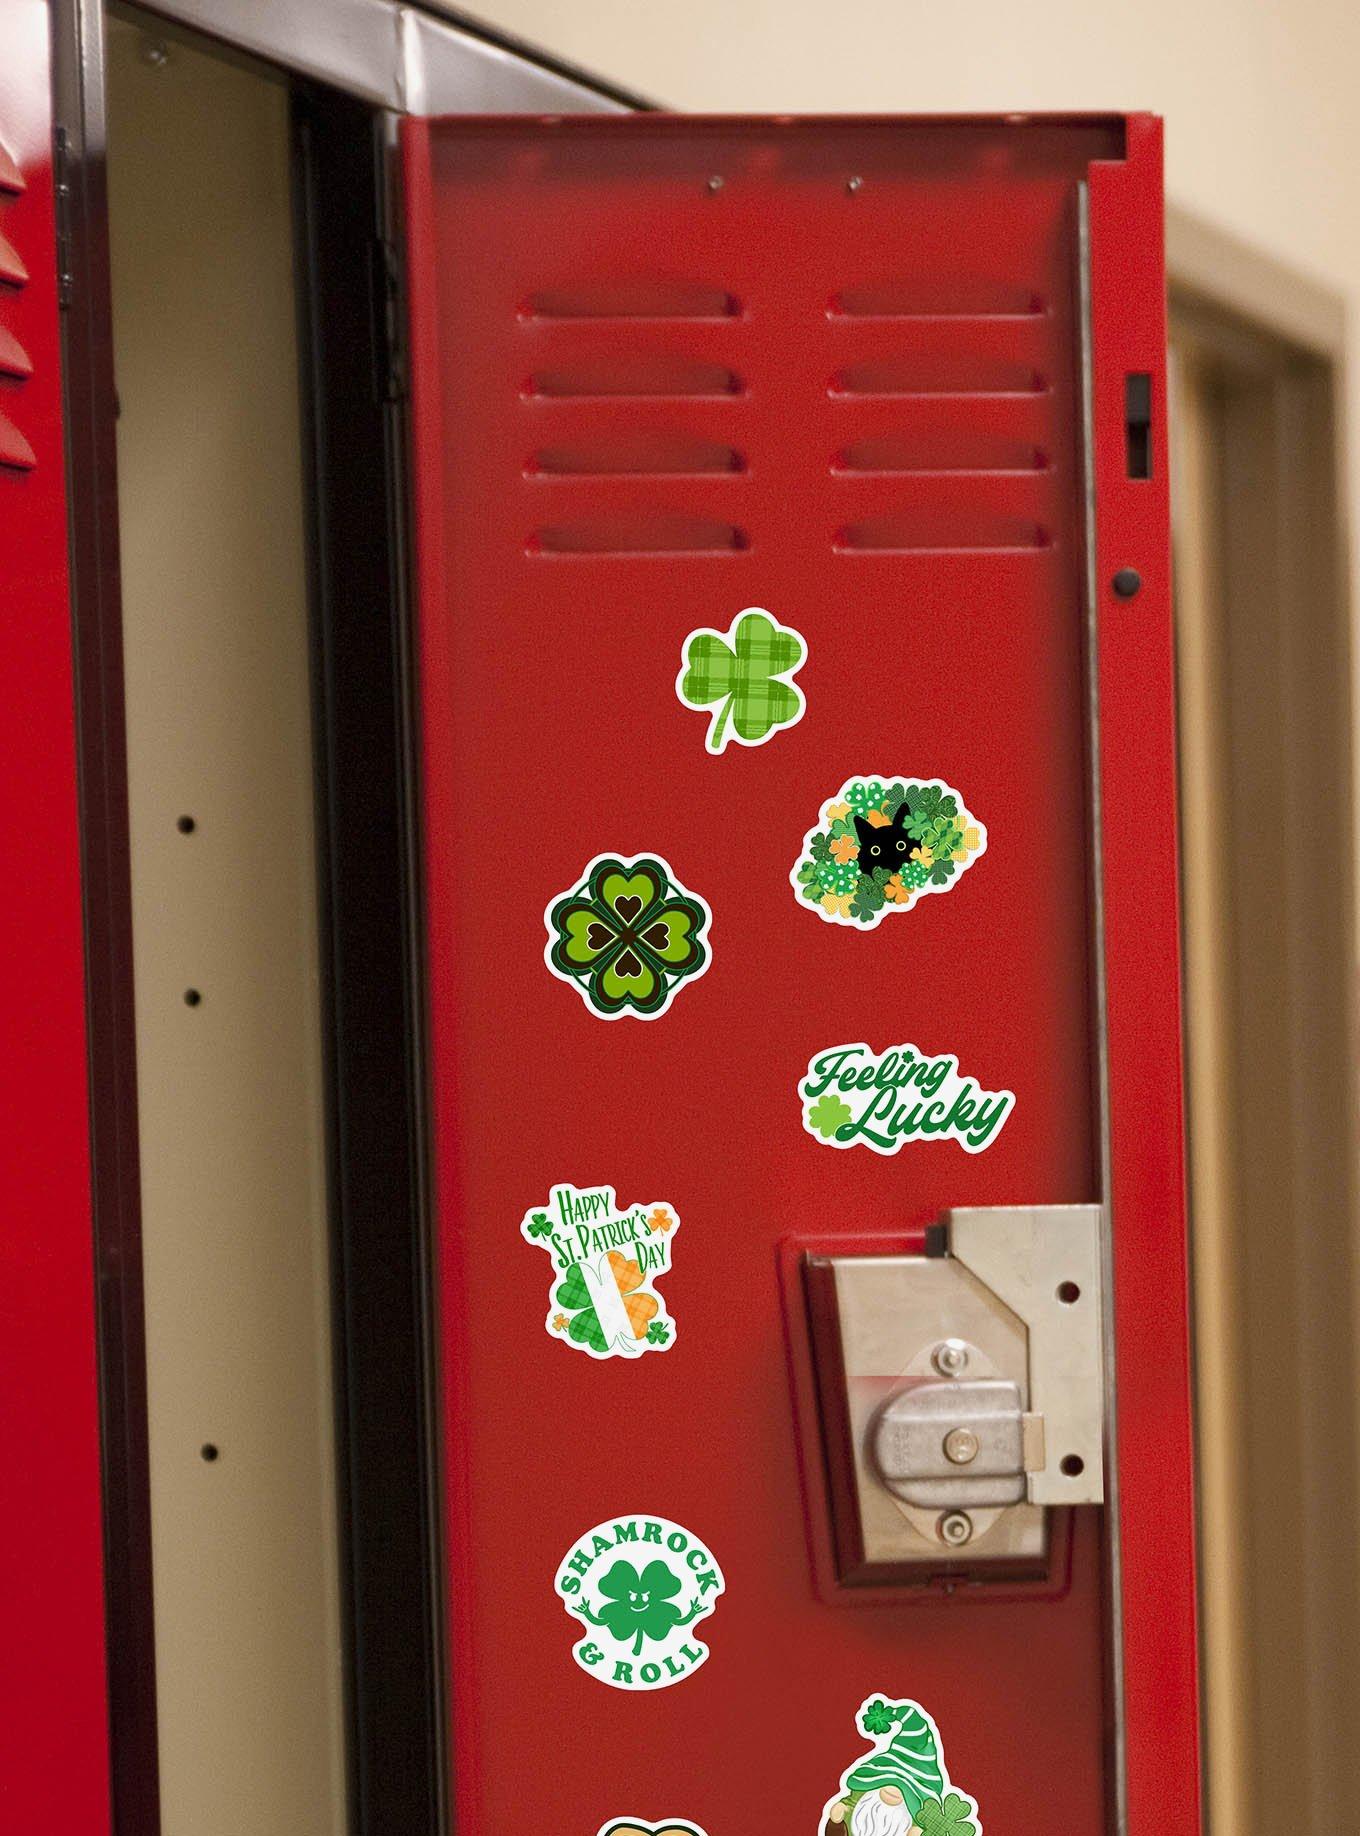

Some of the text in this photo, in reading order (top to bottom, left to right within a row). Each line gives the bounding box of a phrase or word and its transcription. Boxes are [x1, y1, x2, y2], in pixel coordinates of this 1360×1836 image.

[805, 1049, 953, 1098] Feeling
[835, 1084, 1009, 1148] Lucky
[561, 1521, 719, 1596] SHAMROCK
[579, 1642, 703, 1683] & ROLL
